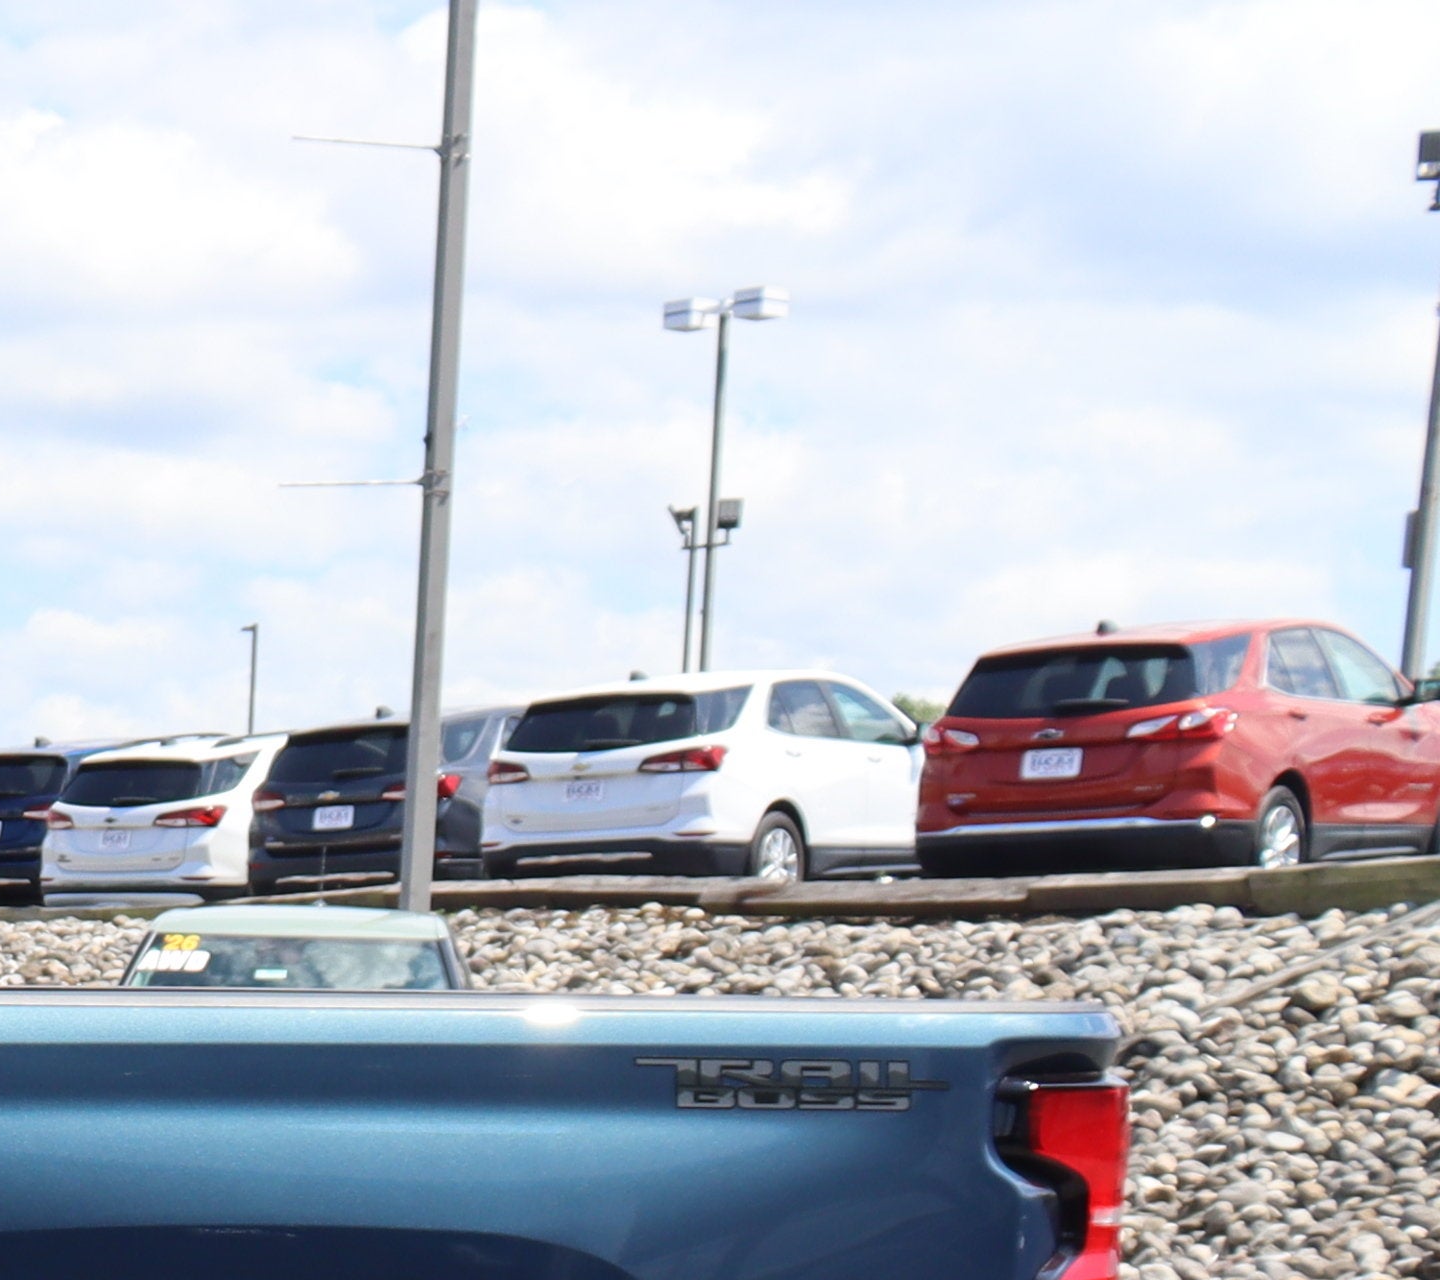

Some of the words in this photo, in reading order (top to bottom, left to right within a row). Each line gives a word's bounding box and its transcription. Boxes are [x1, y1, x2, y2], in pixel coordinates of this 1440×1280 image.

[136, 949, 211, 972] AWD
[634, 1057, 950, 1090] TRAIL
[675, 1084, 911, 1112] BOSS
